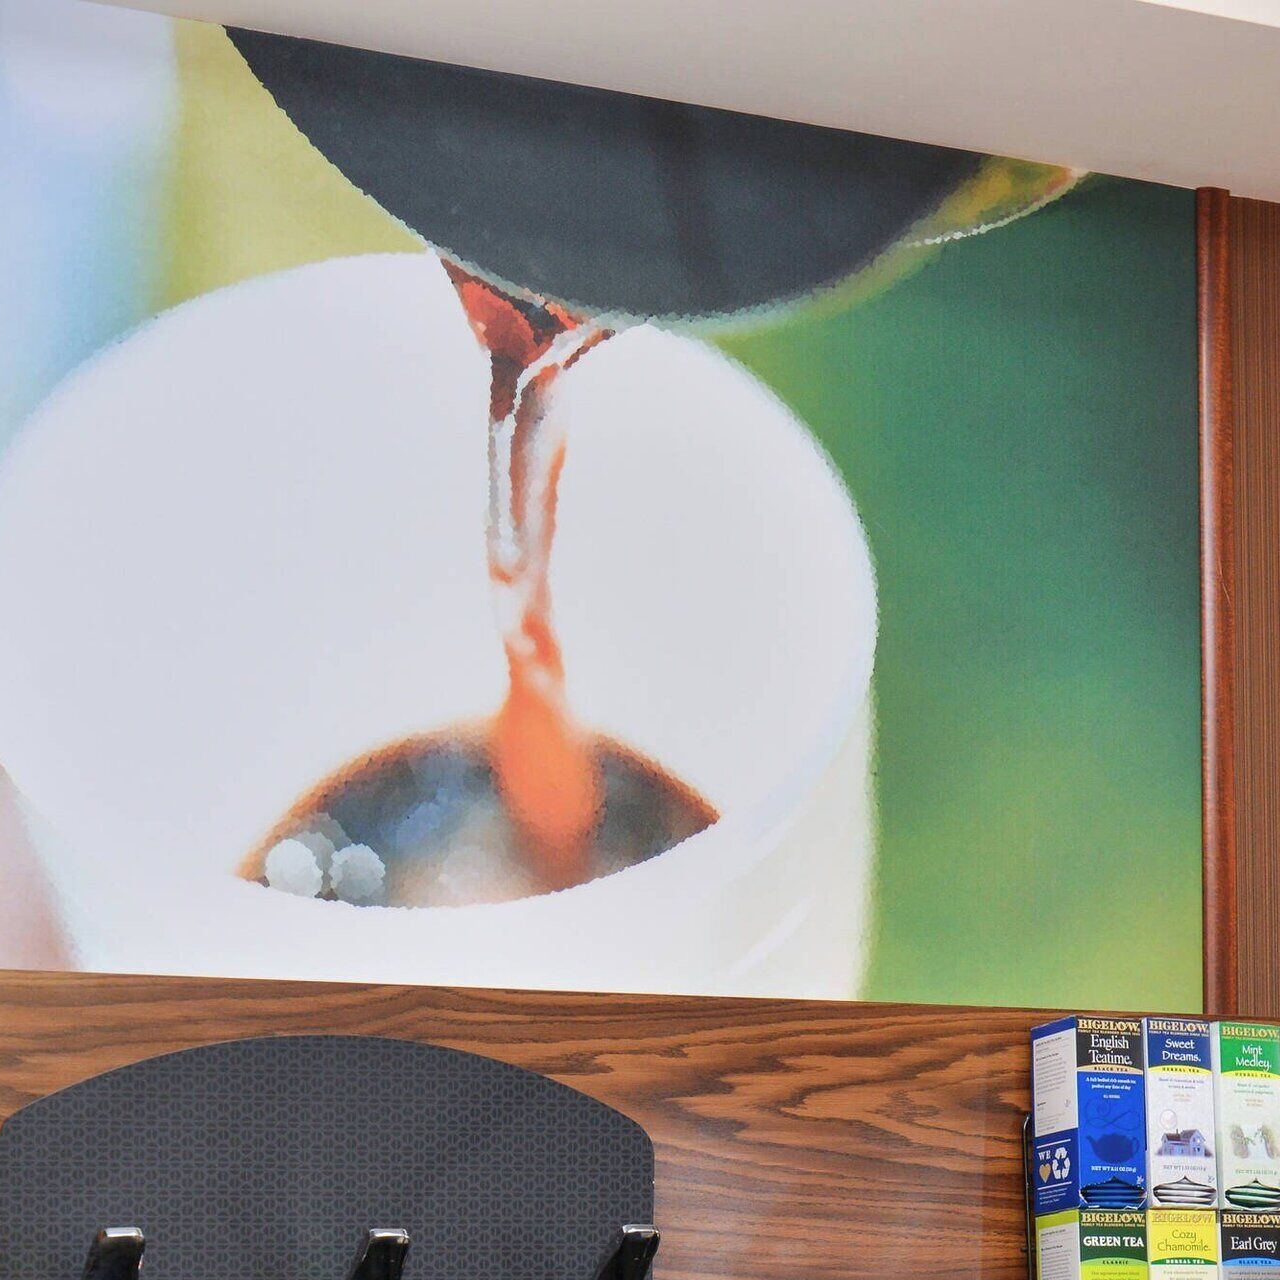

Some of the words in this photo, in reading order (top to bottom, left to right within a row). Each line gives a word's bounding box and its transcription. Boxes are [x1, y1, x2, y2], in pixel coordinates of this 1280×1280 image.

[1078, 1019, 1140, 1031] BIGELOW
[1149, 1020, 1209, 1032] BIGELOW
[1222, 1026, 1279, 1038] BIGELOW
[1090, 1034, 1129, 1051] English
[1165, 1039, 1195, 1049] Sweet
[1242, 1044, 1263, 1055] Mint
[1089, 1050, 1131, 1065] Teatime
[1235, 1053, 1270, 1072] Medley
[1038, 1150, 1051, 1161] WE
[1081, 1213, 1145, 1223] BIGELOW
[1083, 1236, 1121, 1247] GREEN
[1123, 1236, 1145, 1247] TEA
[1172, 1229, 1197, 1243] Cozy
[1157, 1239, 1209, 1252] Chamomile
[1231, 1236, 1252, 1250] Earl
[1253, 1236, 1278, 1253] Grey
